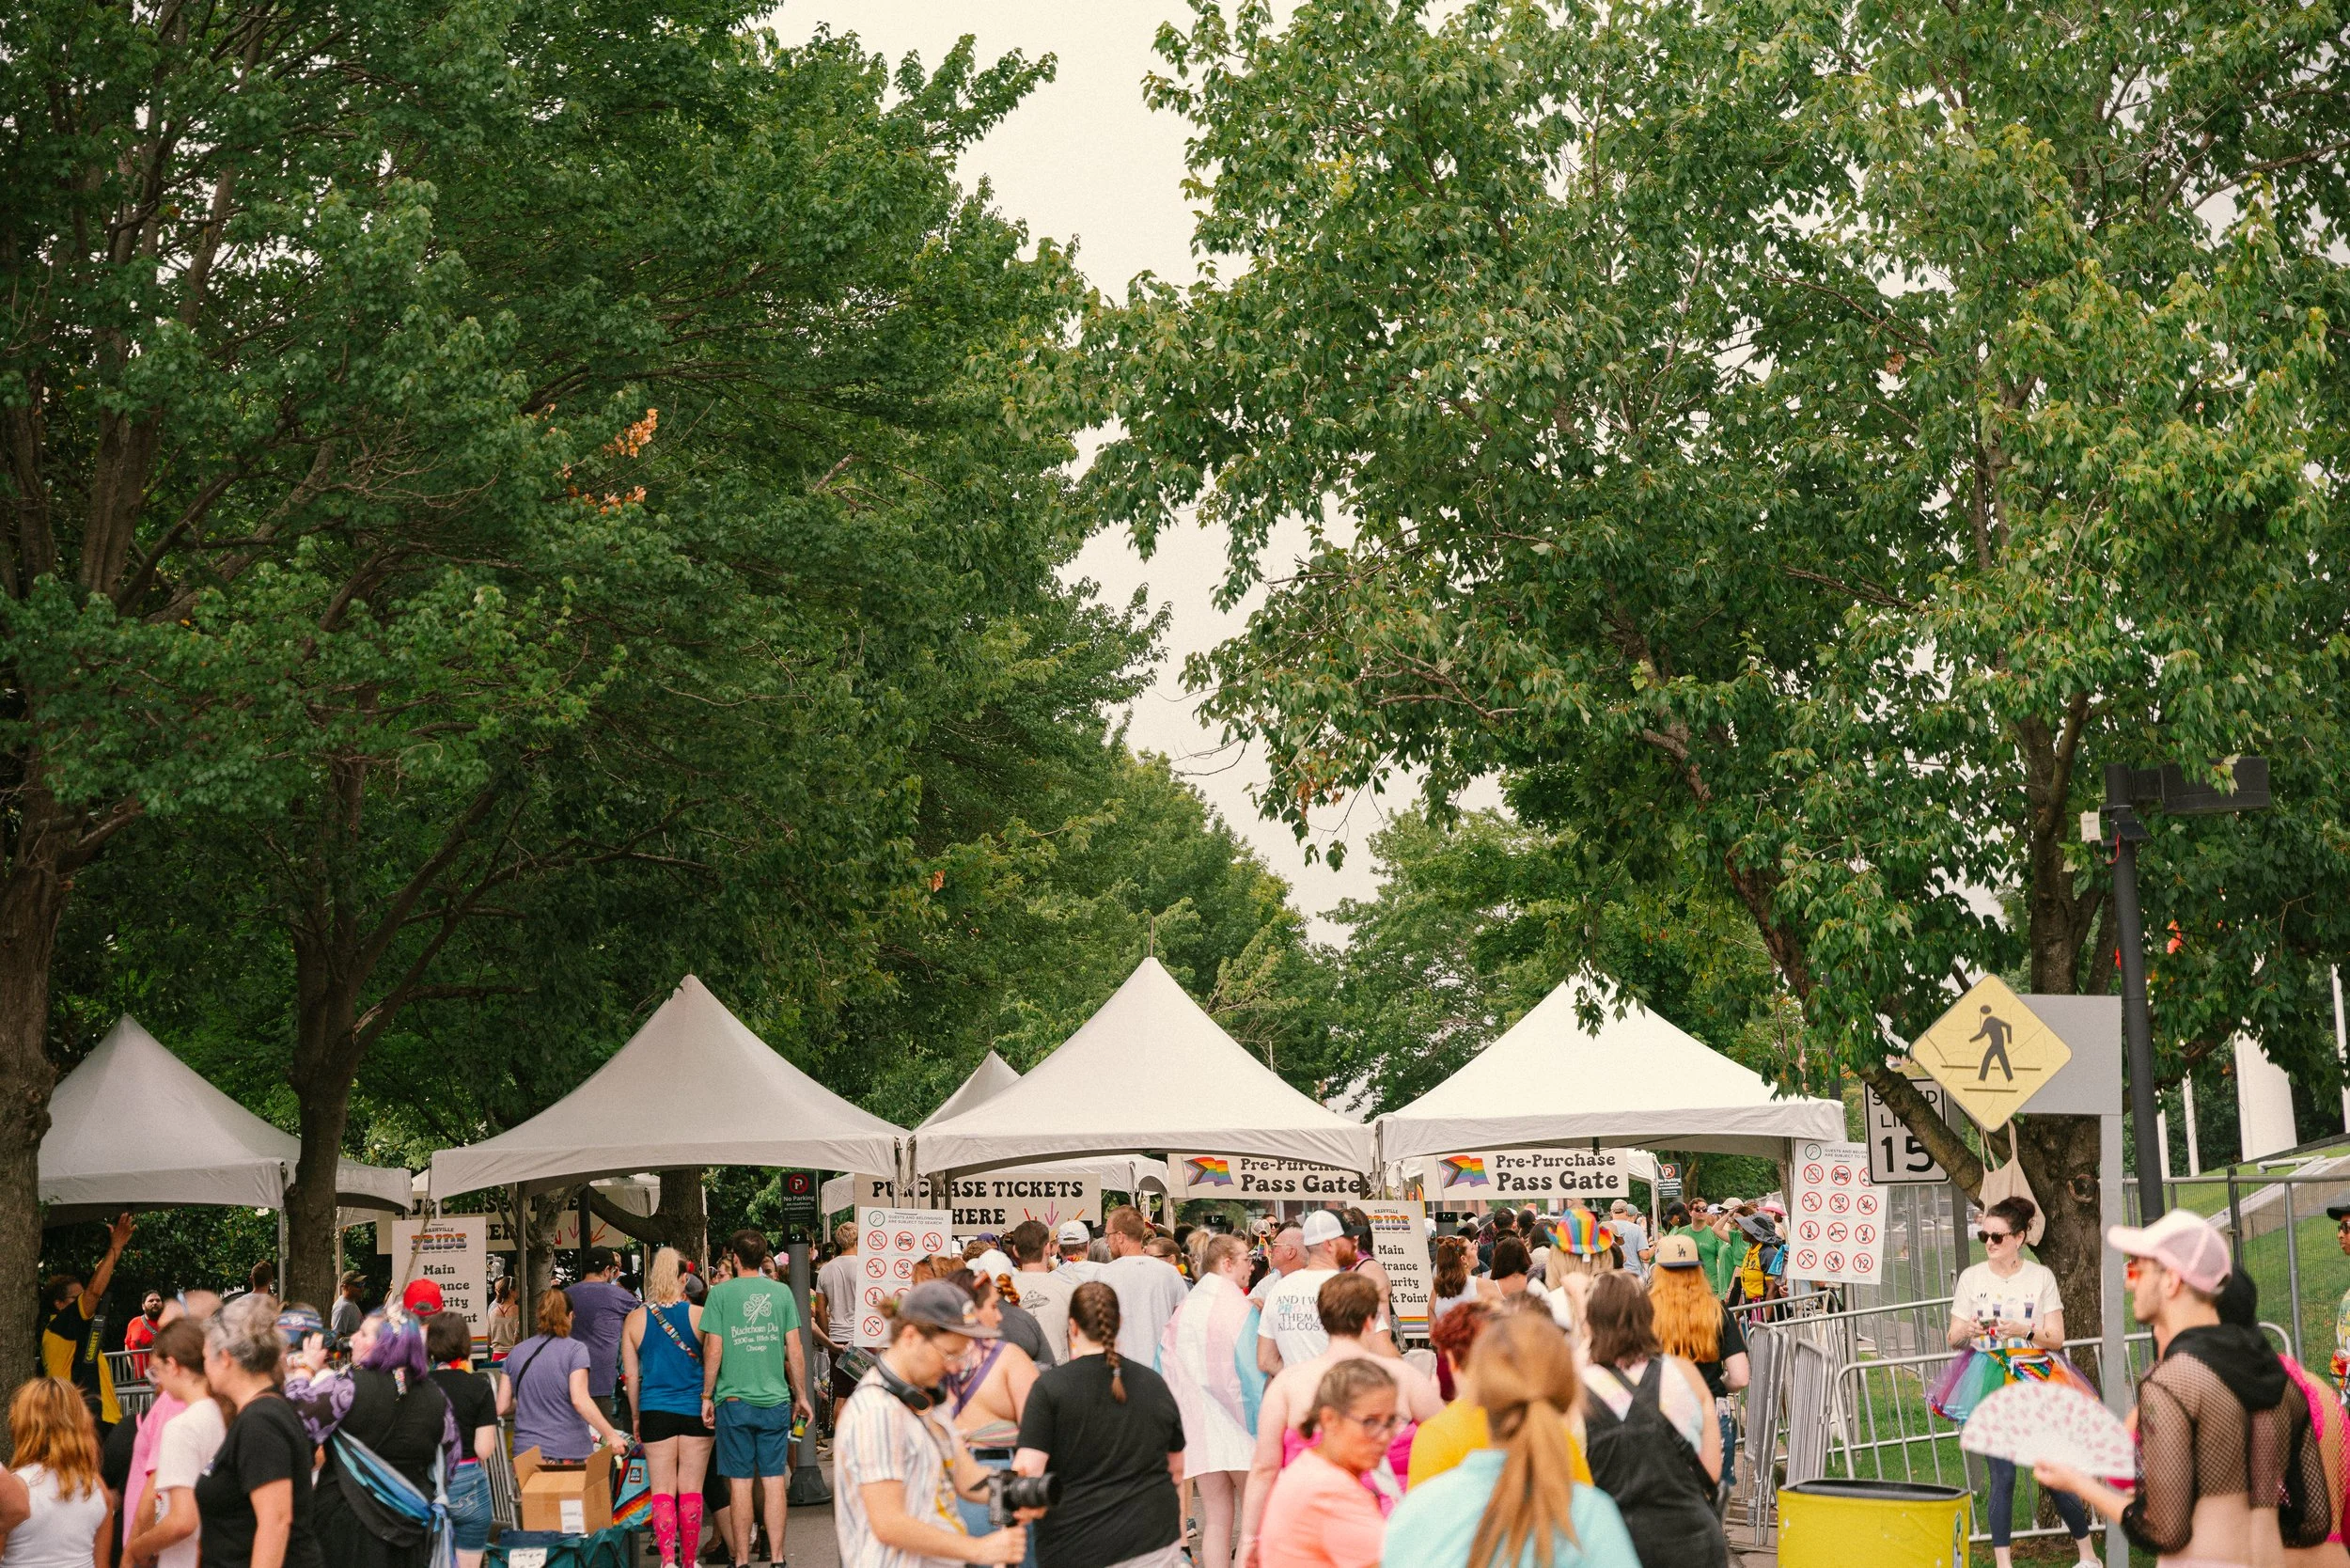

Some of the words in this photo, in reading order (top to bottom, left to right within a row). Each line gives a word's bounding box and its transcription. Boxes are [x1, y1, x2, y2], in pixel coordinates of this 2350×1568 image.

[1496, 1153, 1616, 1168] Pre-Purchase
[1881, 1136, 1935, 1173] 15
[1241, 1174, 1295, 1193] Pass
[1303, 1174, 1360, 1193] Gate
[1496, 1172, 1553, 1191] Pass
[1559, 1170, 1619, 1190] Gate
[992, 1181, 1084, 1198] TICKETS
[952, 1208, 1006, 1225] HERE
[411, 1232, 467, 1250] PRIDE
[1378, 1245, 1404, 1255] Main
[423, 1264, 456, 1276] Main
[1383, 1262, 1418, 1271] trance
[440, 1282, 470, 1291] ance
[1391, 1278, 1419, 1289] urity
[443, 1297, 469, 1309] rity
[1277, 1295, 1298, 1305] AND
[1401, 1293, 1428, 1303] Point
[1279, 1313, 1313, 1323] THEM
[1278, 1323, 1294, 1331] ALL
[1297, 1322, 1321, 1331] COS
[86, 1331, 99, 1360] GARRETT
